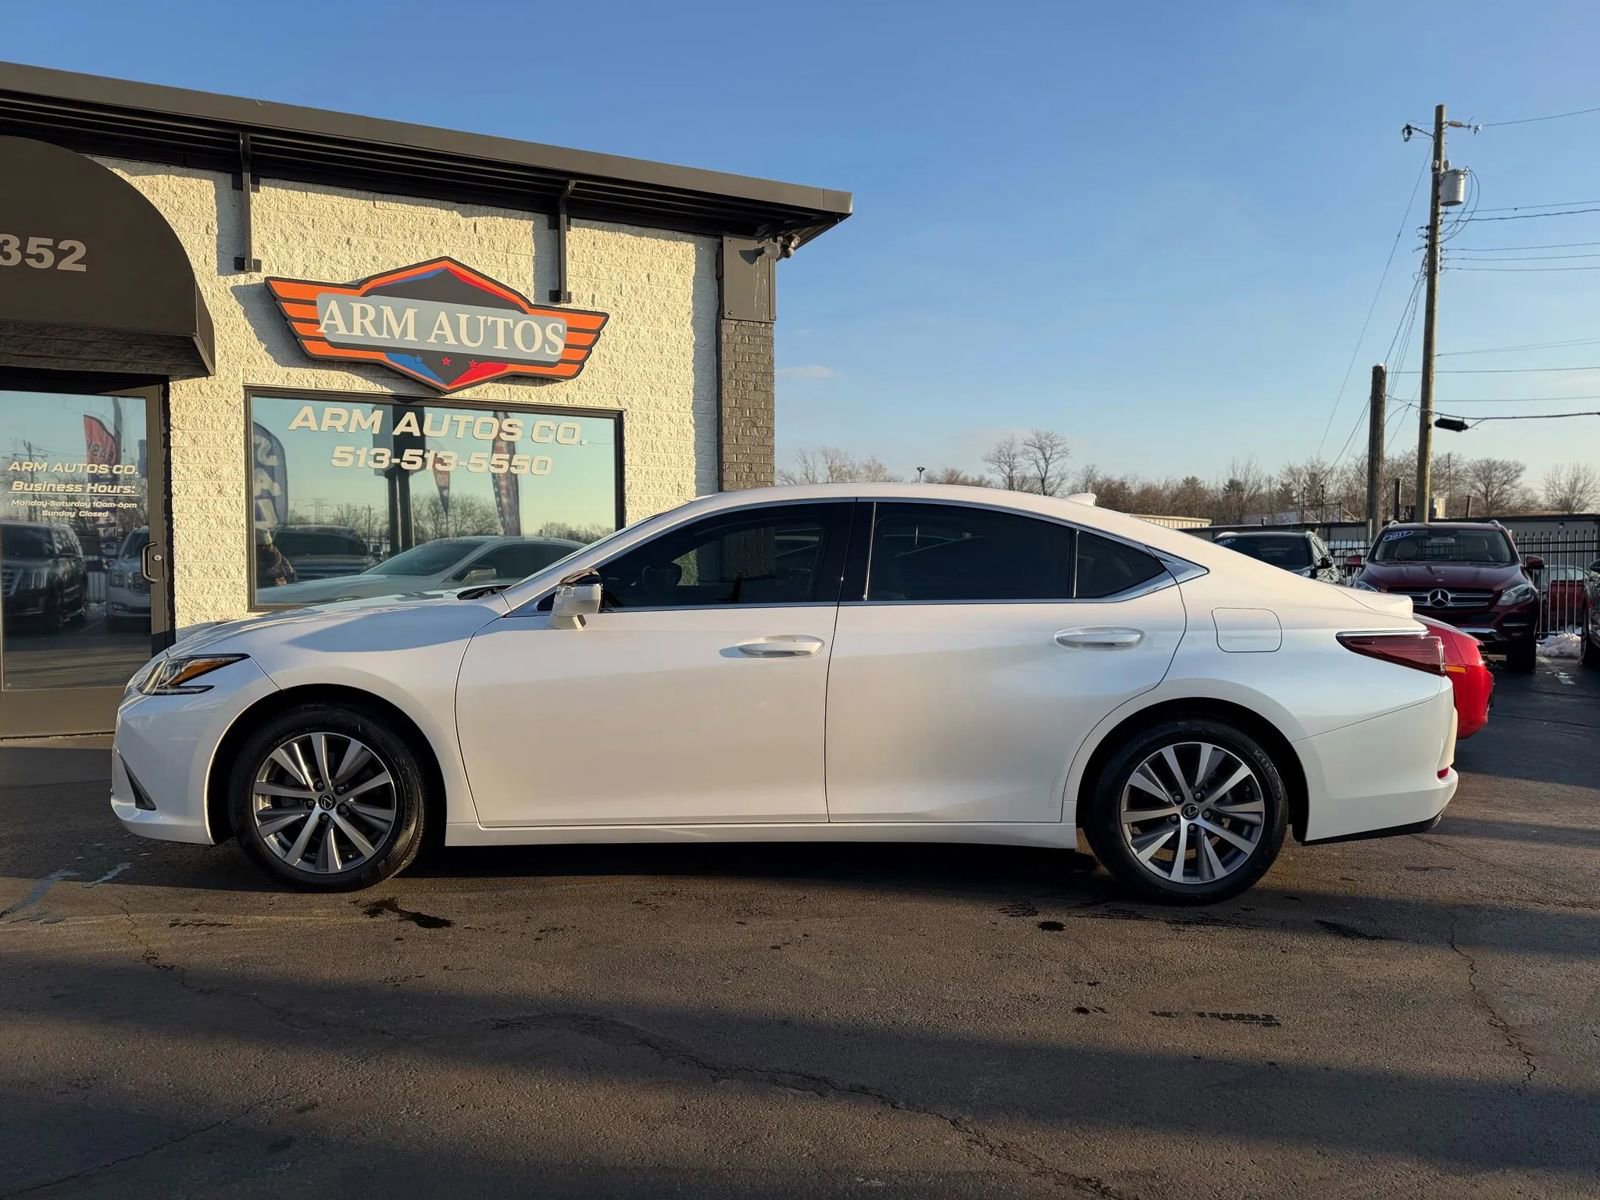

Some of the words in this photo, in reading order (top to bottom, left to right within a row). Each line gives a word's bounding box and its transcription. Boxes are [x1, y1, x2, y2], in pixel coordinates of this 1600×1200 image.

[0, 233, 87, 272] 352
[316, 299, 418, 341] ARM
[427, 310, 565, 355] AUTOS
[288, 405, 384, 434] ARM
[392, 411, 524, 442] AUTOS
[532, 421, 587, 446] CO.
[9, 461, 48, 472] ARM
[52, 463, 110, 474] AUTOS
[112, 464, 138, 475] CO.
[331, 446, 552, 475] 513-513-5550
[12, 481, 82, 492] Business
[86, 483, 135, 493] Hours:
[11, 499, 91, 509] Monday-Saturday
[92, 501, 137, 509] 10am-6pm
[42, 509, 75, 518] Sunday
[79, 510, 109, 518] Closed
